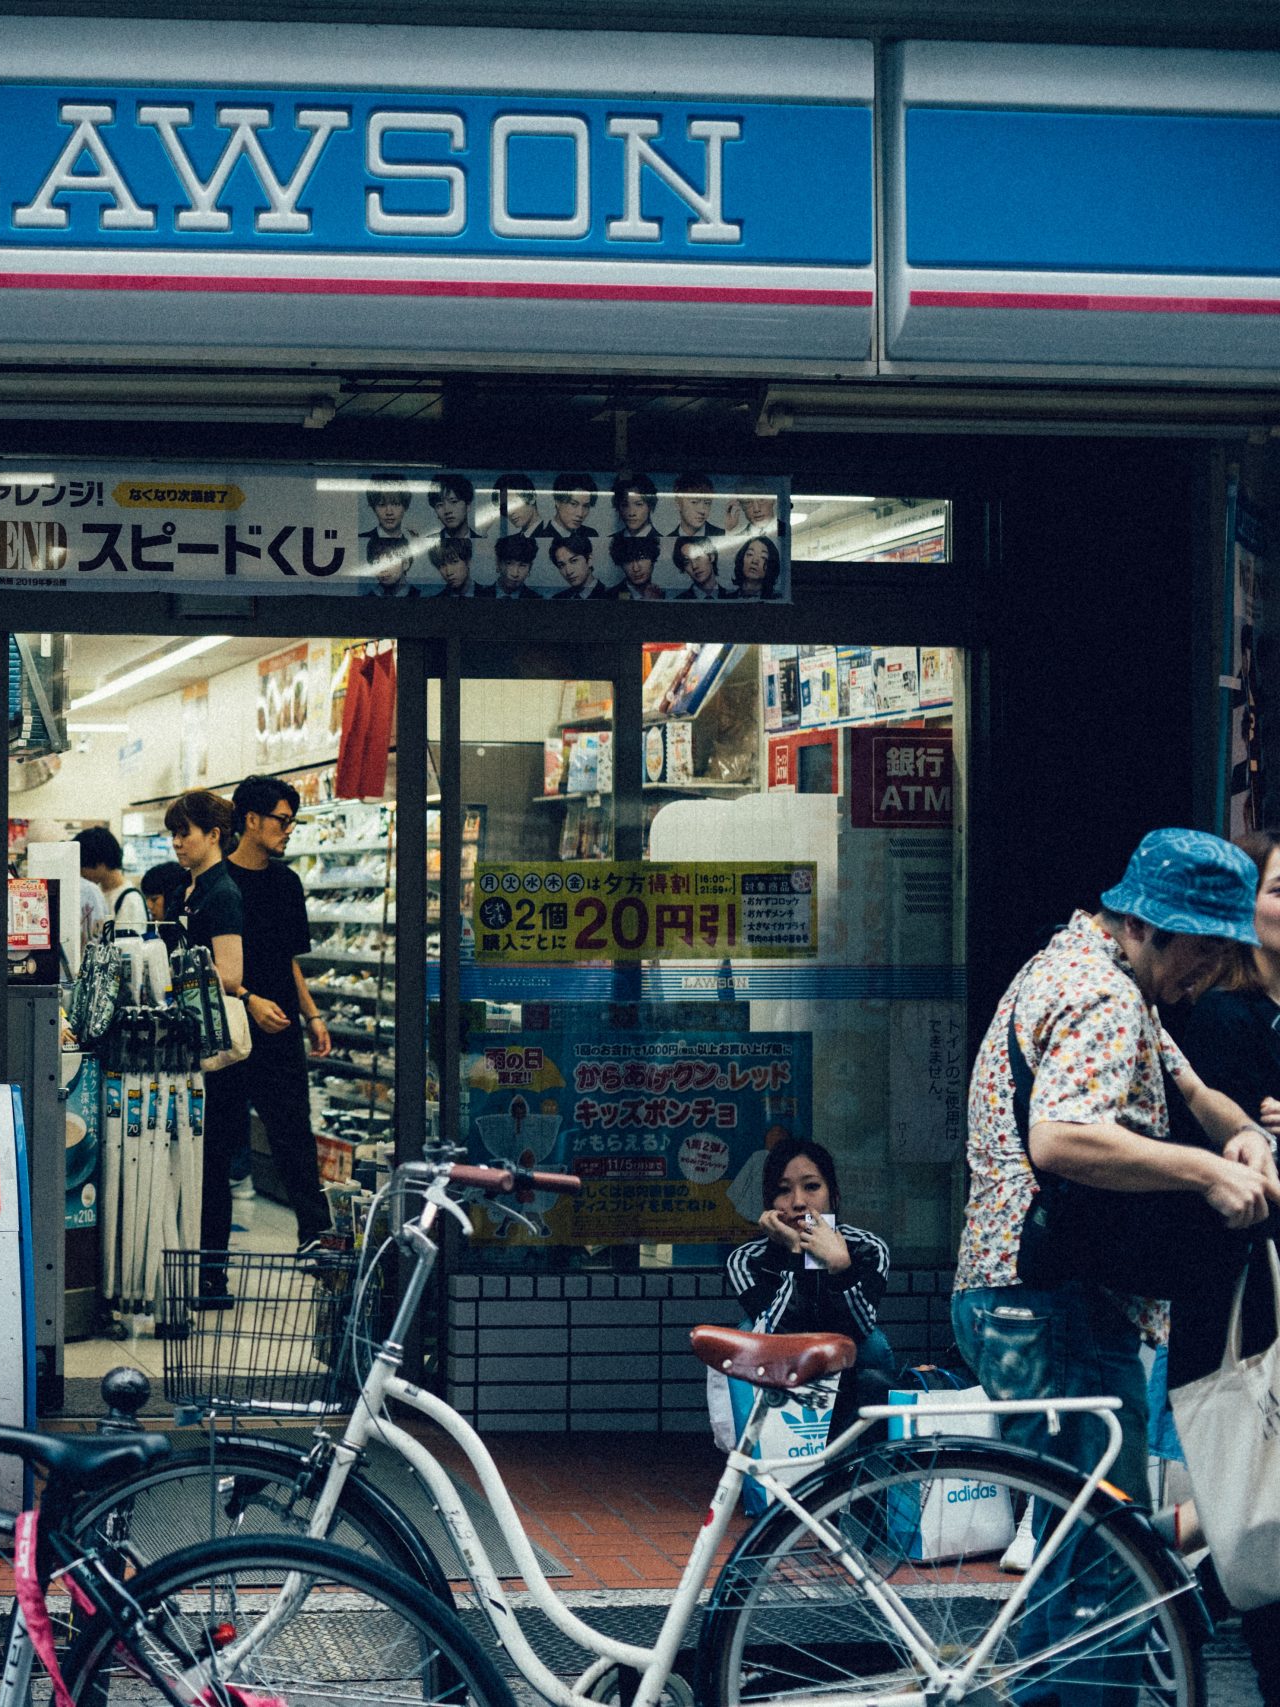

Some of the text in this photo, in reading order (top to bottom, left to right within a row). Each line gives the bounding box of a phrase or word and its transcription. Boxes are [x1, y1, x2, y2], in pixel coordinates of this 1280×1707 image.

[78, 521, 346, 577] スピードくじ
[885, 746, 945, 778] 銀行
[879, 785, 952, 812] ATM
[515, 898, 568, 931] 2個
[573, 896, 736, 949] 20円引
[481, 933, 568, 951] 購入ごとに
[682, 976, 749, 989] LAWSON
[485, 1048, 545, 1071] 雨の日
[575, 1098, 738, 1129] キッズポンチョ
[946, 1484, 998, 1504] adidas
